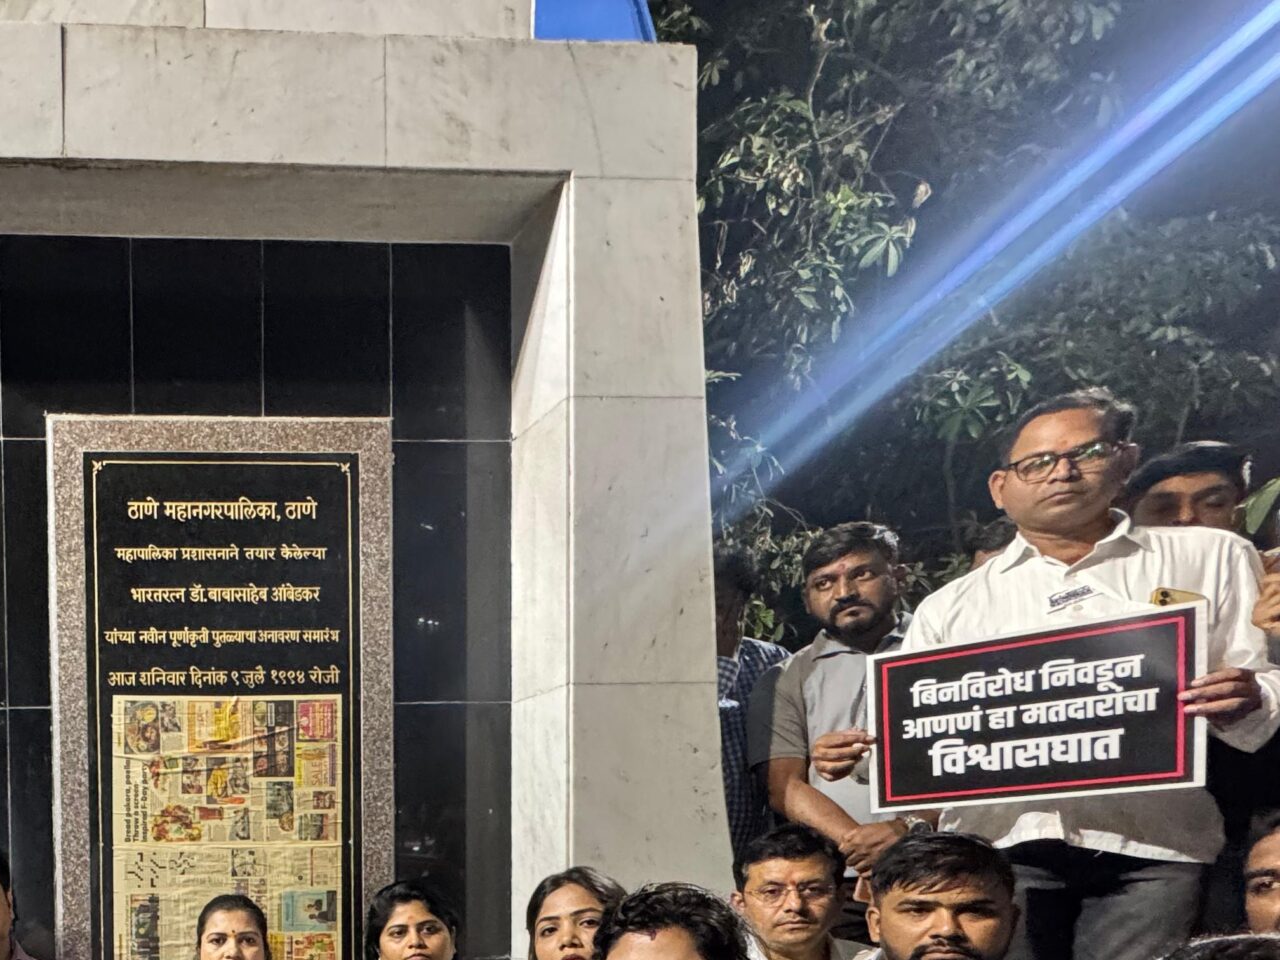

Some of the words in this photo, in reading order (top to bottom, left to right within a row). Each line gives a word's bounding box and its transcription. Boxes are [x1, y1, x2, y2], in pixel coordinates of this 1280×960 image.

[128, 497, 159, 520] ठाणे
[164, 497, 281, 521] महानगरपालिका,
[285, 497, 318, 520] ठाणे
[115, 544, 178, 562] महापालिका
[180, 544, 239, 560] प्रशासनाने
[243, 547, 276, 560] तयार
[278, 544, 327, 560] केलेल्या
[130, 586, 186, 603] भारतरत्न
[104, 628, 136, 644] यांच्या
[139, 626, 167, 644] नवीन
[258, 630, 300, 644] अनावरण
[302, 627, 340, 644] समारंभ
[108, 671, 136, 686] आज
[139, 667, 187, 686] शनिवार
[189, 665, 229, 688] दिनांक
[231, 670, 239, 685] ९
[241, 665, 266, 688] जुलै
[308, 665, 341, 685] रोजी
[910, 668, 1036, 708] बिनविरोध
[1040, 654, 1145, 692] निवडून
[902, 705, 985, 740] आणणं
[986, 705, 1016, 730] हा
[928, 727, 1125, 777] विश्वासघात
